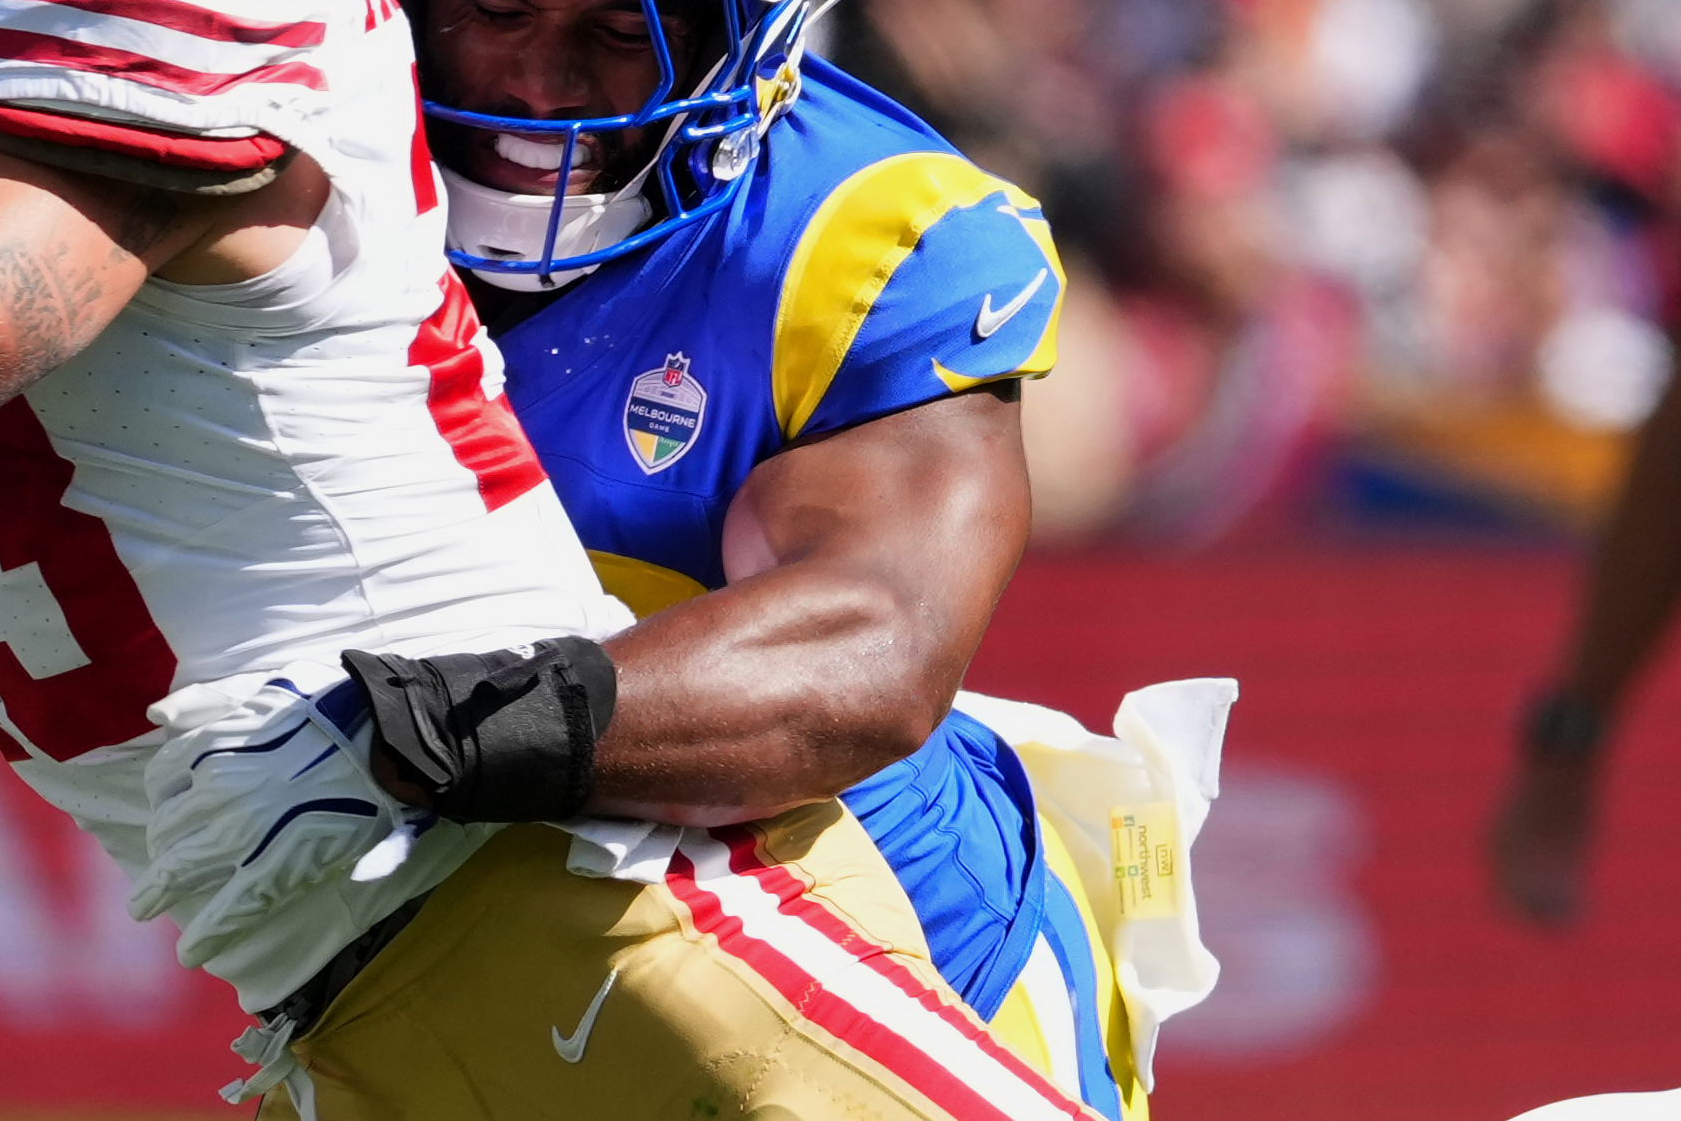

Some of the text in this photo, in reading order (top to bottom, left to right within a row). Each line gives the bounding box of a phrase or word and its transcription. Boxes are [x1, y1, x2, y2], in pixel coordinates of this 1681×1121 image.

[629, 403, 697, 429] MELBOURNE
[648, 421, 670, 433] GAME
[1138, 825, 1152, 900] northwest
